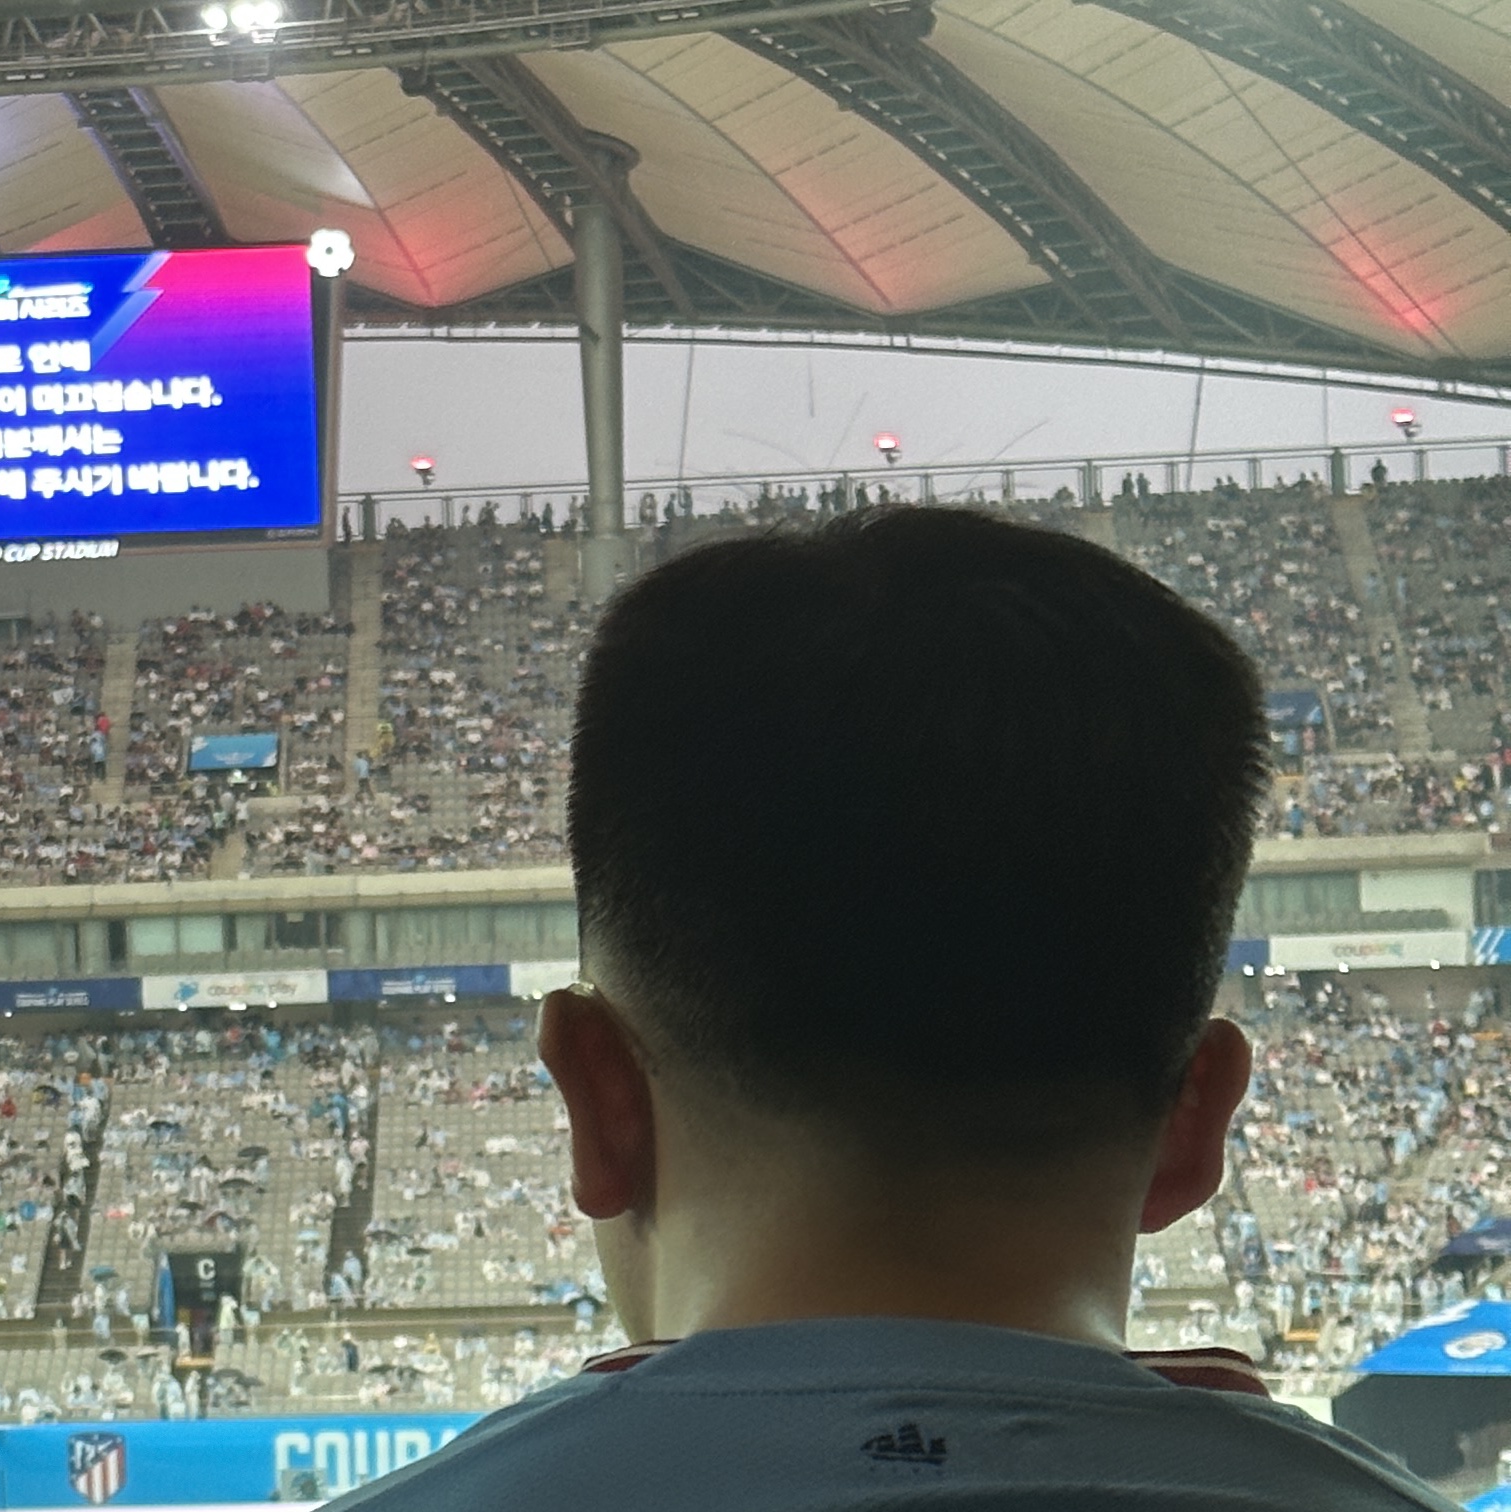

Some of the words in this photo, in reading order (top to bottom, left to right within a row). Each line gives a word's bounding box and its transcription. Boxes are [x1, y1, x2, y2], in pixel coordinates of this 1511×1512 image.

[4, 542, 41, 562] CUP
[40, 539, 120, 561] STADIUM
[198, 1258, 217, 1281] C
[274, 1429, 456, 1497] COUP
